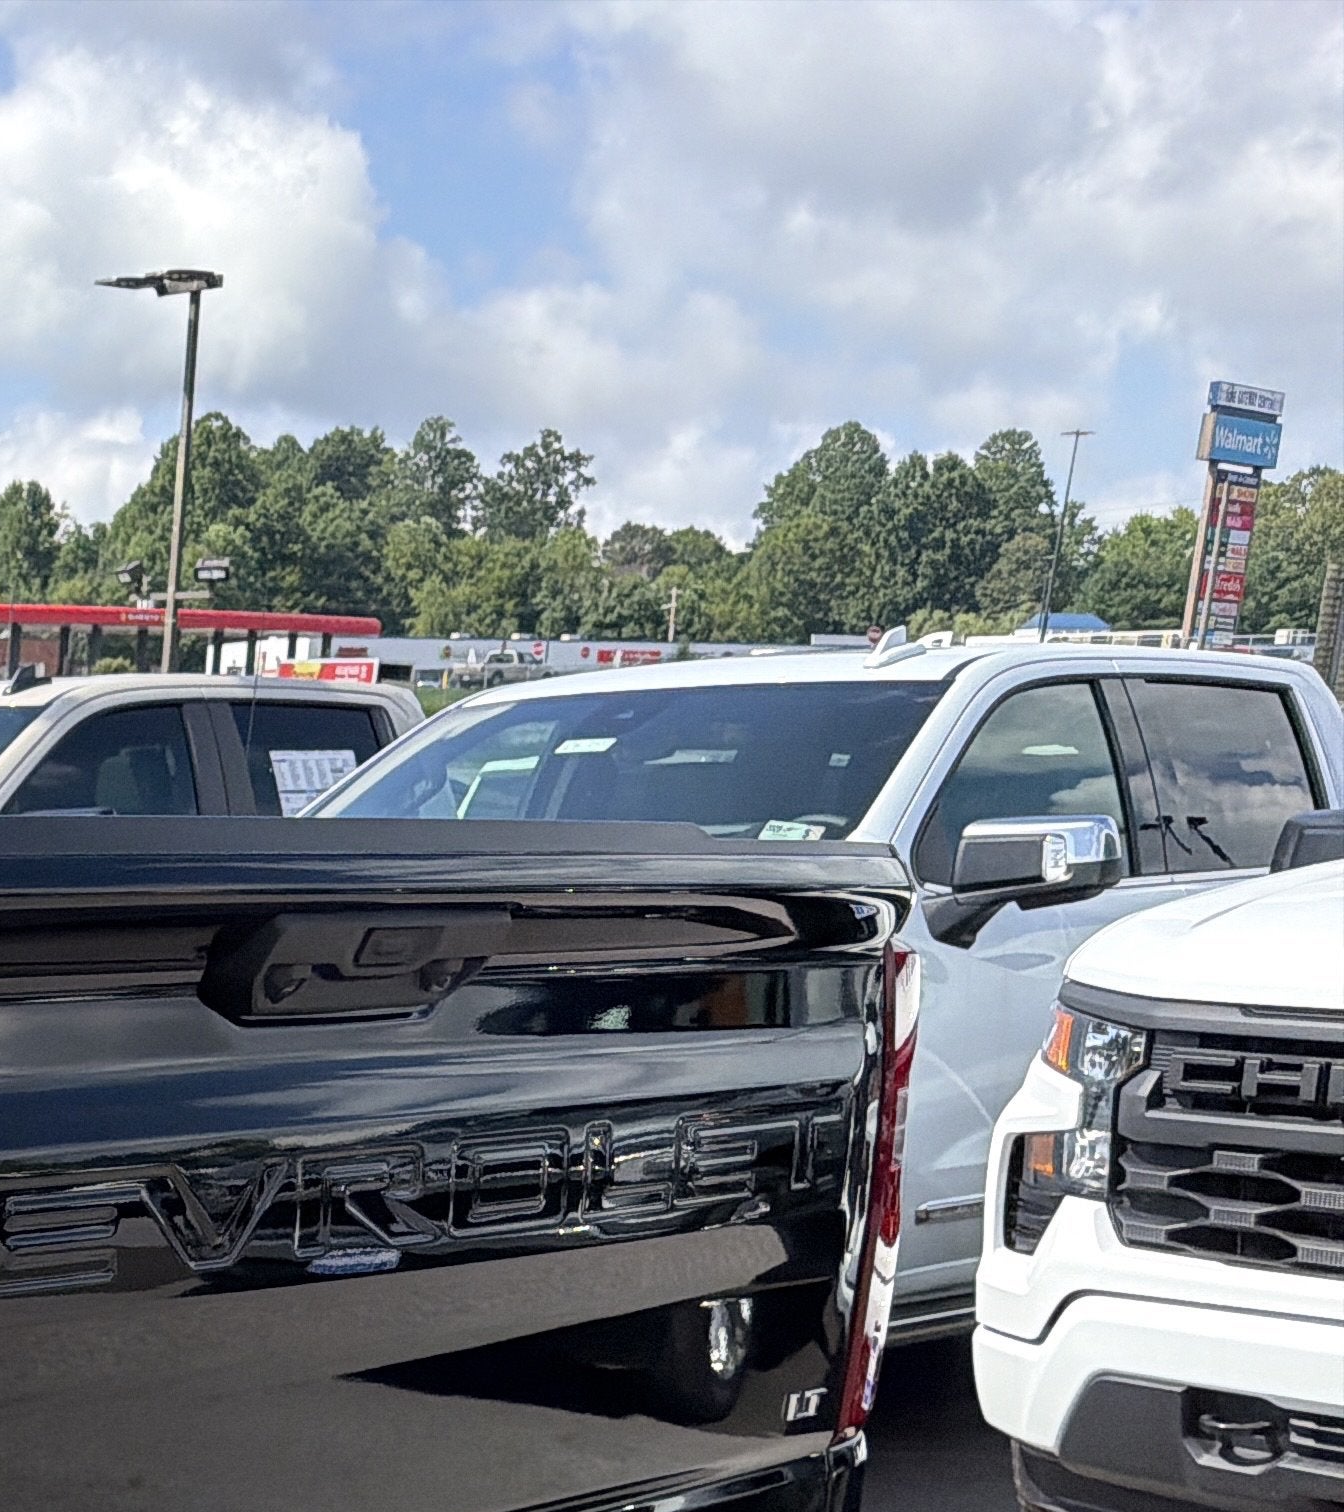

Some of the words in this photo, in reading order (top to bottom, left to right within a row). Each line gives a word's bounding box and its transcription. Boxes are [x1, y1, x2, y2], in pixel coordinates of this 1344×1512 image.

[1215, 425, 1264, 455] Walmart
[1164, 1051, 1343, 1106] CH
[786, 1387, 828, 1421] LT
